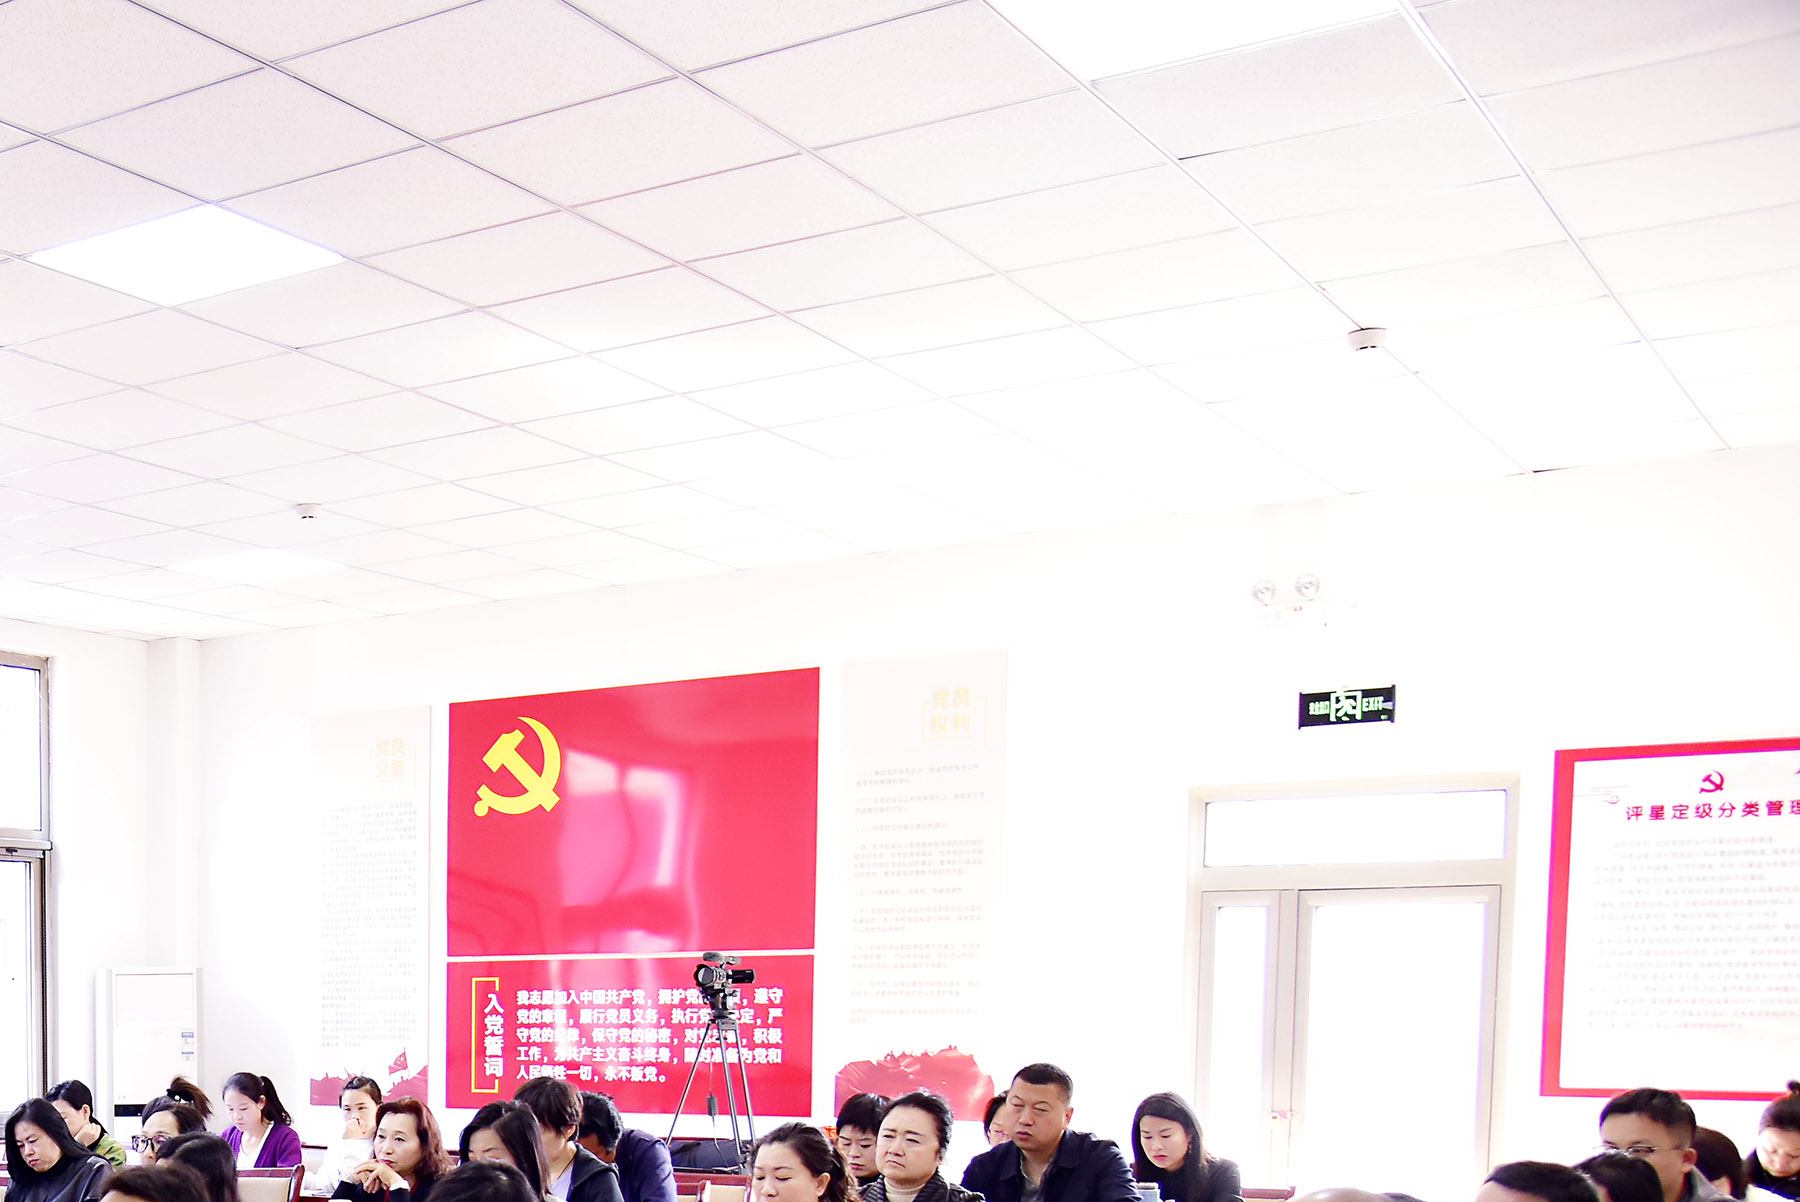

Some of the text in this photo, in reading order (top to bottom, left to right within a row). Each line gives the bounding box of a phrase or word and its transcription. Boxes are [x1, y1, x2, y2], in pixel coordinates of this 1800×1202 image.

[1362, 696, 1384, 711] EXIT
[484, 993, 504, 1077] 入党誓词
